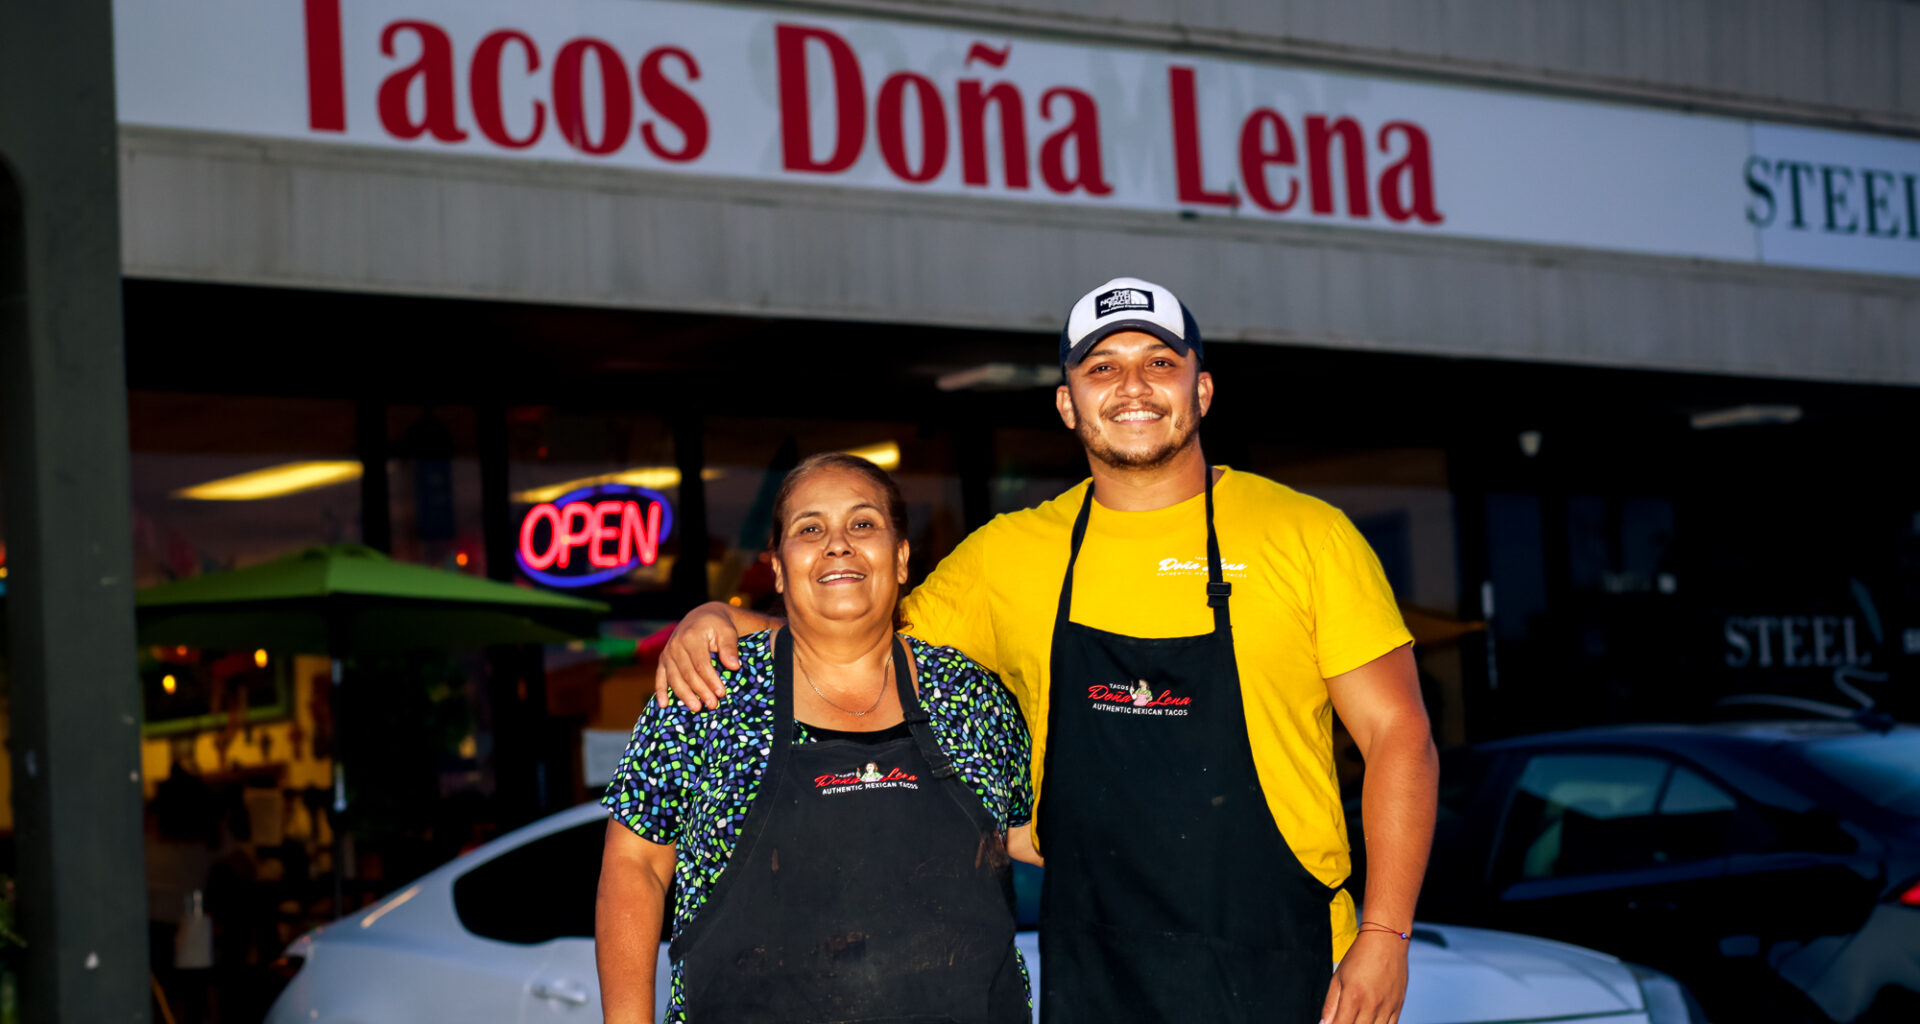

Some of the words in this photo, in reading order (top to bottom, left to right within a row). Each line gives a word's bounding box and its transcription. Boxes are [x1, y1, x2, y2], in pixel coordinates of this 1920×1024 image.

[303, 0, 711, 163] Tacos
[775, 23, 1114, 196] Doña
[1169, 65, 1445, 225] Lena
[519, 500, 662, 571] OPEN
[1723, 615, 1873, 668] STEEL
[1087, 684, 1133, 703] Doña
[1146, 689, 1192, 707] Lena
[1109, 683, 1129, 691] TACOS
[1092, 702, 1132, 714] AUTHENTIC
[1132, 707, 1163, 716] MEXICAN
[1165, 708, 1188, 716] TACOS
[822, 783, 863, 796] AUTHENTIC
[865, 782, 897, 790] MEXICAN
[900, 782, 918, 790] TACOS
